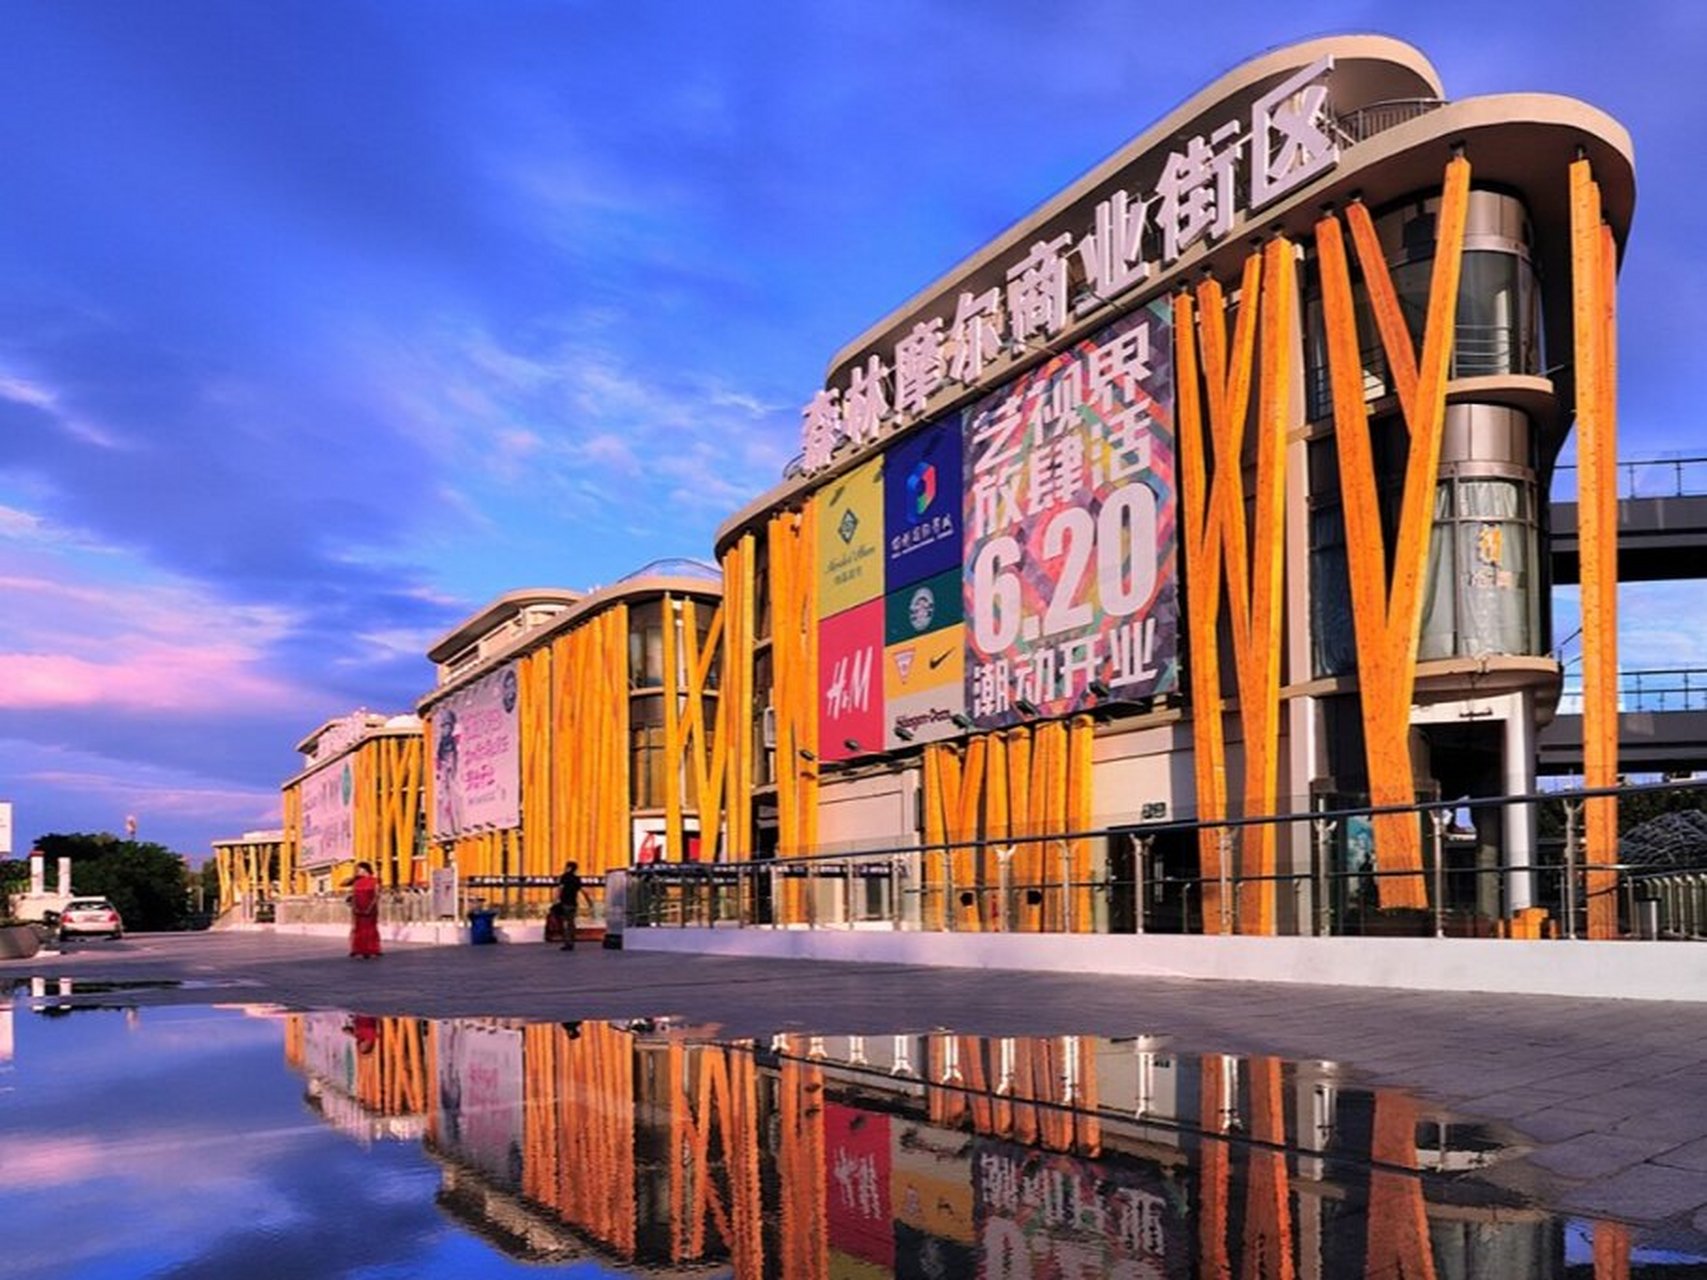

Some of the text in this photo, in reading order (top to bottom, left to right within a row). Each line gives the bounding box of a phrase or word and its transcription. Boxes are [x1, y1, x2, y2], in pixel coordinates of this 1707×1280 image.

[974, 482, 1157, 654] 6.20
[826, 646, 873, 720] H&M
[973, 617, 1157, 718] 潮动开业
